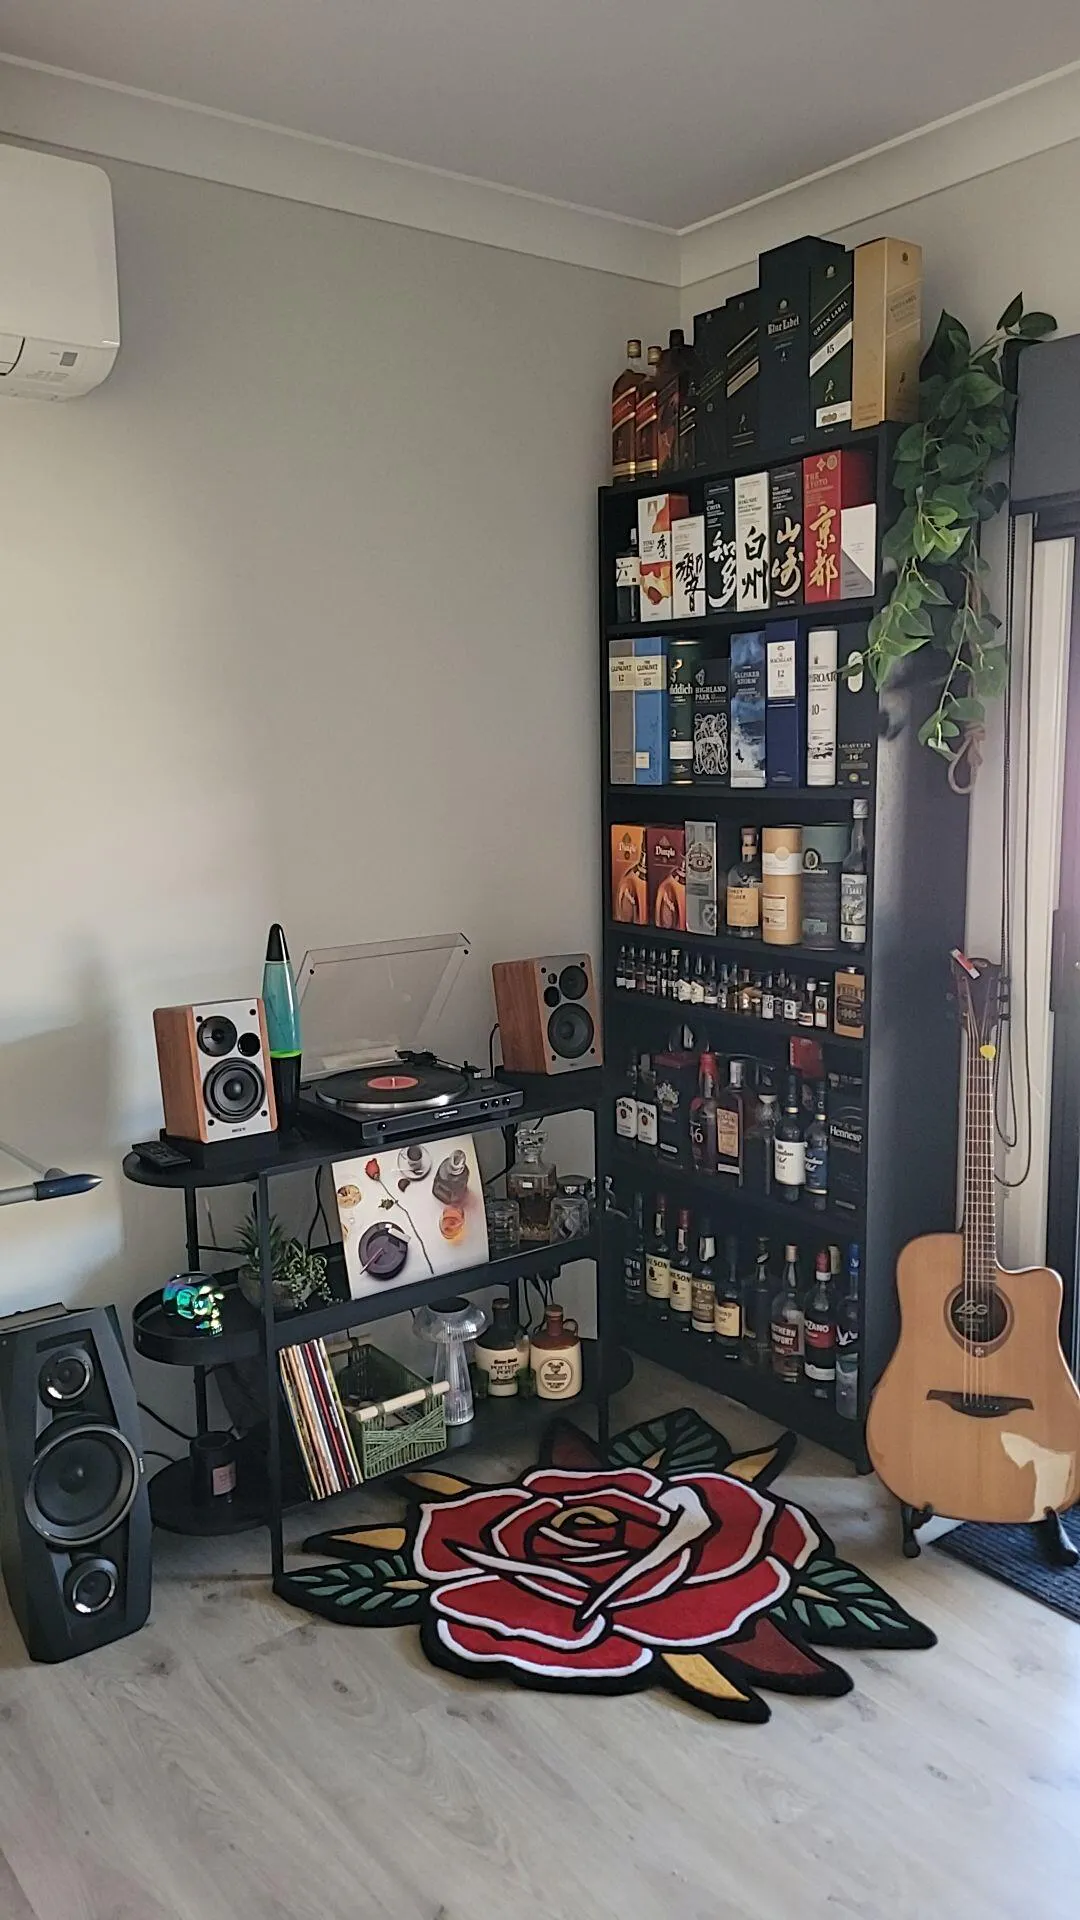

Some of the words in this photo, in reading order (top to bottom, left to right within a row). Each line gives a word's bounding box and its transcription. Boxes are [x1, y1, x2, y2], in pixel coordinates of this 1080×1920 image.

[767, 320, 783, 335] Blue
[782, 315, 800, 332] Label
[812, 316, 832, 337] GREEN
[831, 300, 849, 321] LABEL
[826, 343, 835, 355] 15
[807, 505, 839, 599] 京都
[777, 669, 785, 679] 12
[669, 682, 693, 695] iddich
[695, 685, 727, 694] HIGHLAND
[695, 693, 711, 701] PARK
[811, 703, 820, 716] 10
